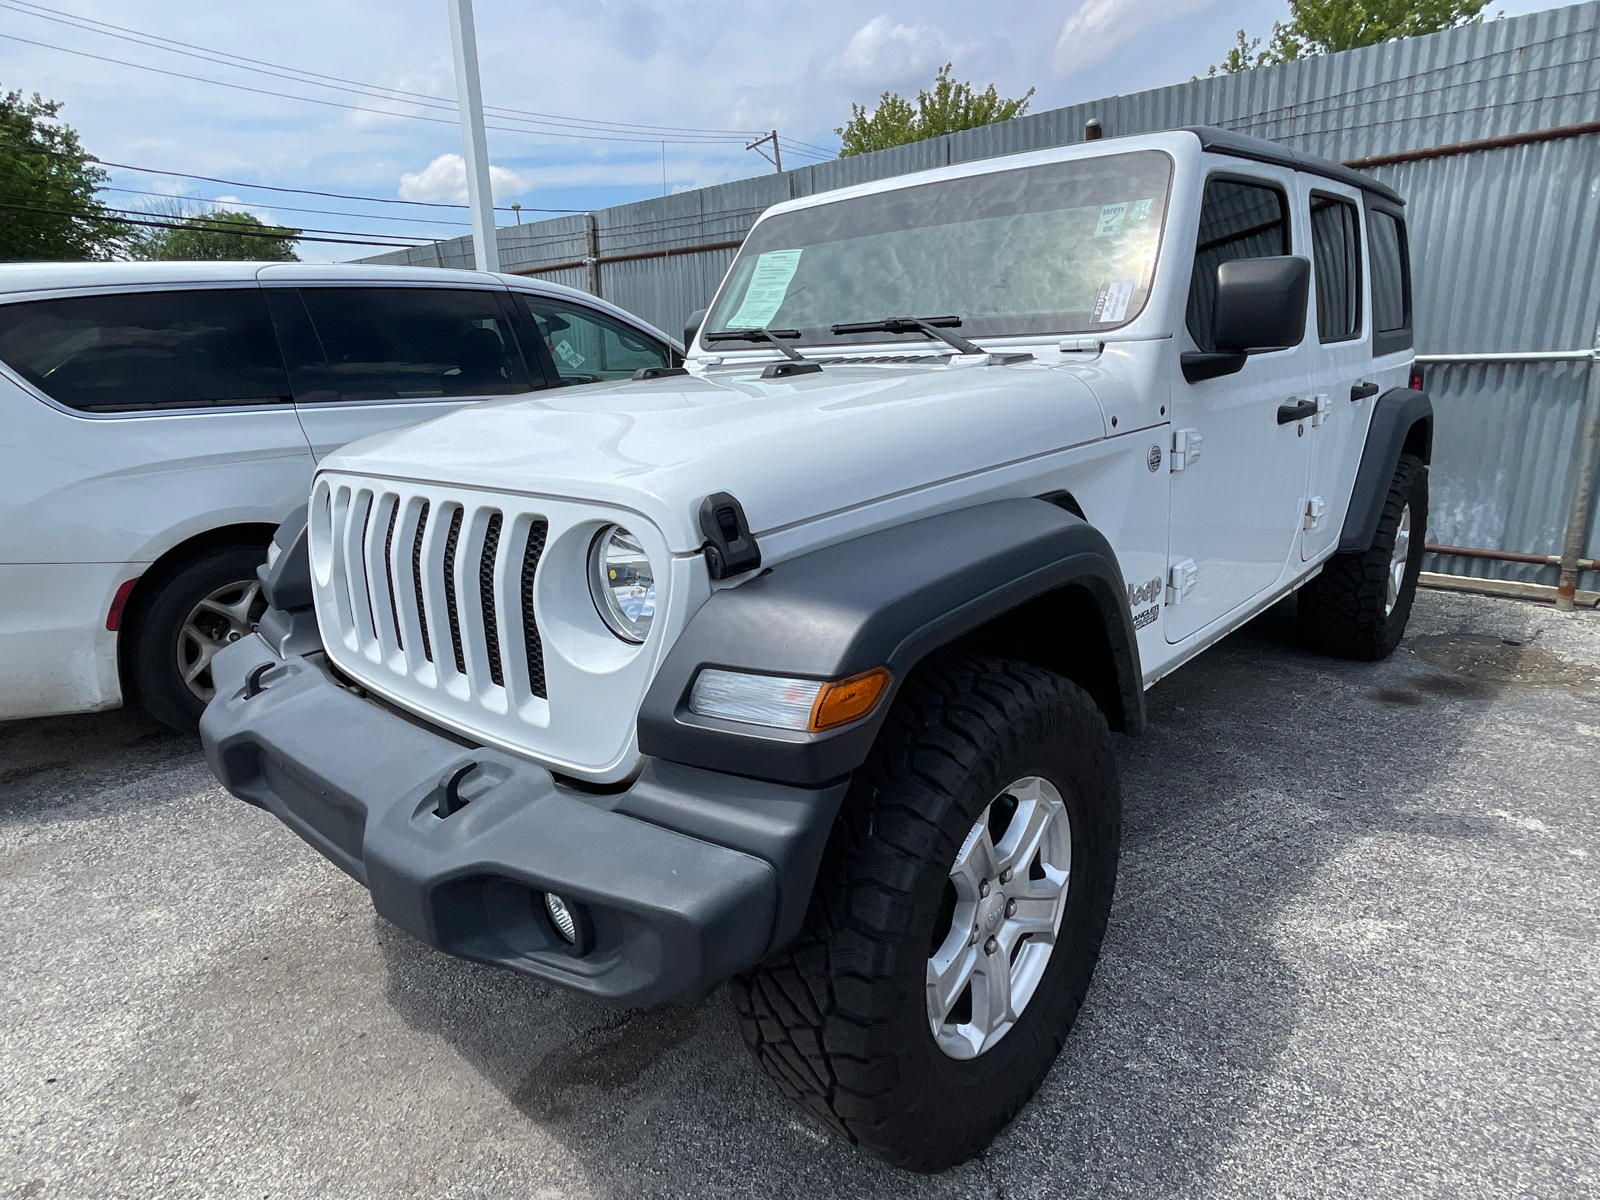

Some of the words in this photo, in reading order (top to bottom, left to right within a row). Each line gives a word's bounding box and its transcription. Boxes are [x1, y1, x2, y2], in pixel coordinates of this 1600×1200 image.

[1102, 207, 1125, 216] SAFETY
[1128, 576, 1162, 606] Jeep
[1133, 604, 1159, 621] ANGLER
